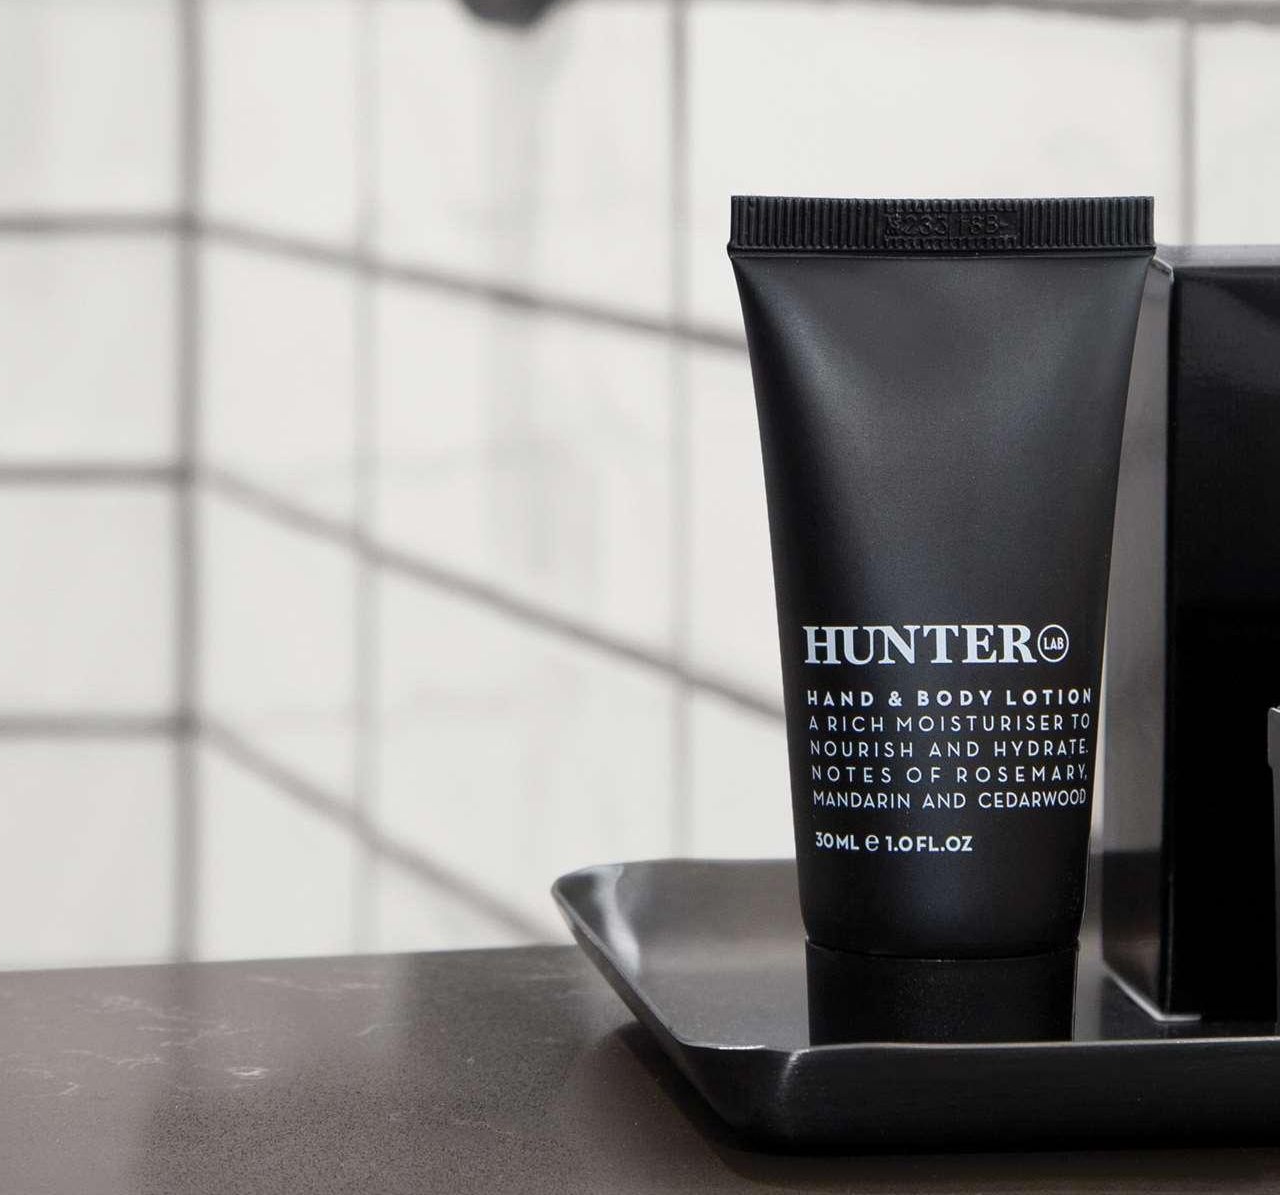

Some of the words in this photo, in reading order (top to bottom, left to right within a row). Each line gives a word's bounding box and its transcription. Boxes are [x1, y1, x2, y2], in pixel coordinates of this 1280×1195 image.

[802, 623, 1038, 665] HUNTER
[807, 689, 874, 707] HAND
[887, 690, 903, 707] &
[917, 689, 993, 707] BODY
[1006, 687, 1091, 707] LOTION
[809, 715, 819, 731] A
[827, 715, 884, 732] RICH
[896, 714, 1063, 732] MOISTURISER
[1071, 712, 1091, 729] TO
[810, 740, 913, 758] NOURISH
[928, 740, 980, 758] AND
[994, 738, 1089, 758] HYDRATE.
[811, 765, 892, 784] NOTES
[906, 766, 941, 784] OF
[956, 763, 1087, 783] ROSEMARY,
[813, 790, 911, 809] MANDARIN
[922, 792, 967, 809] AND
[977, 787, 1087, 809] CEDARWOOD
[815, 831, 860, 851] 30ML
